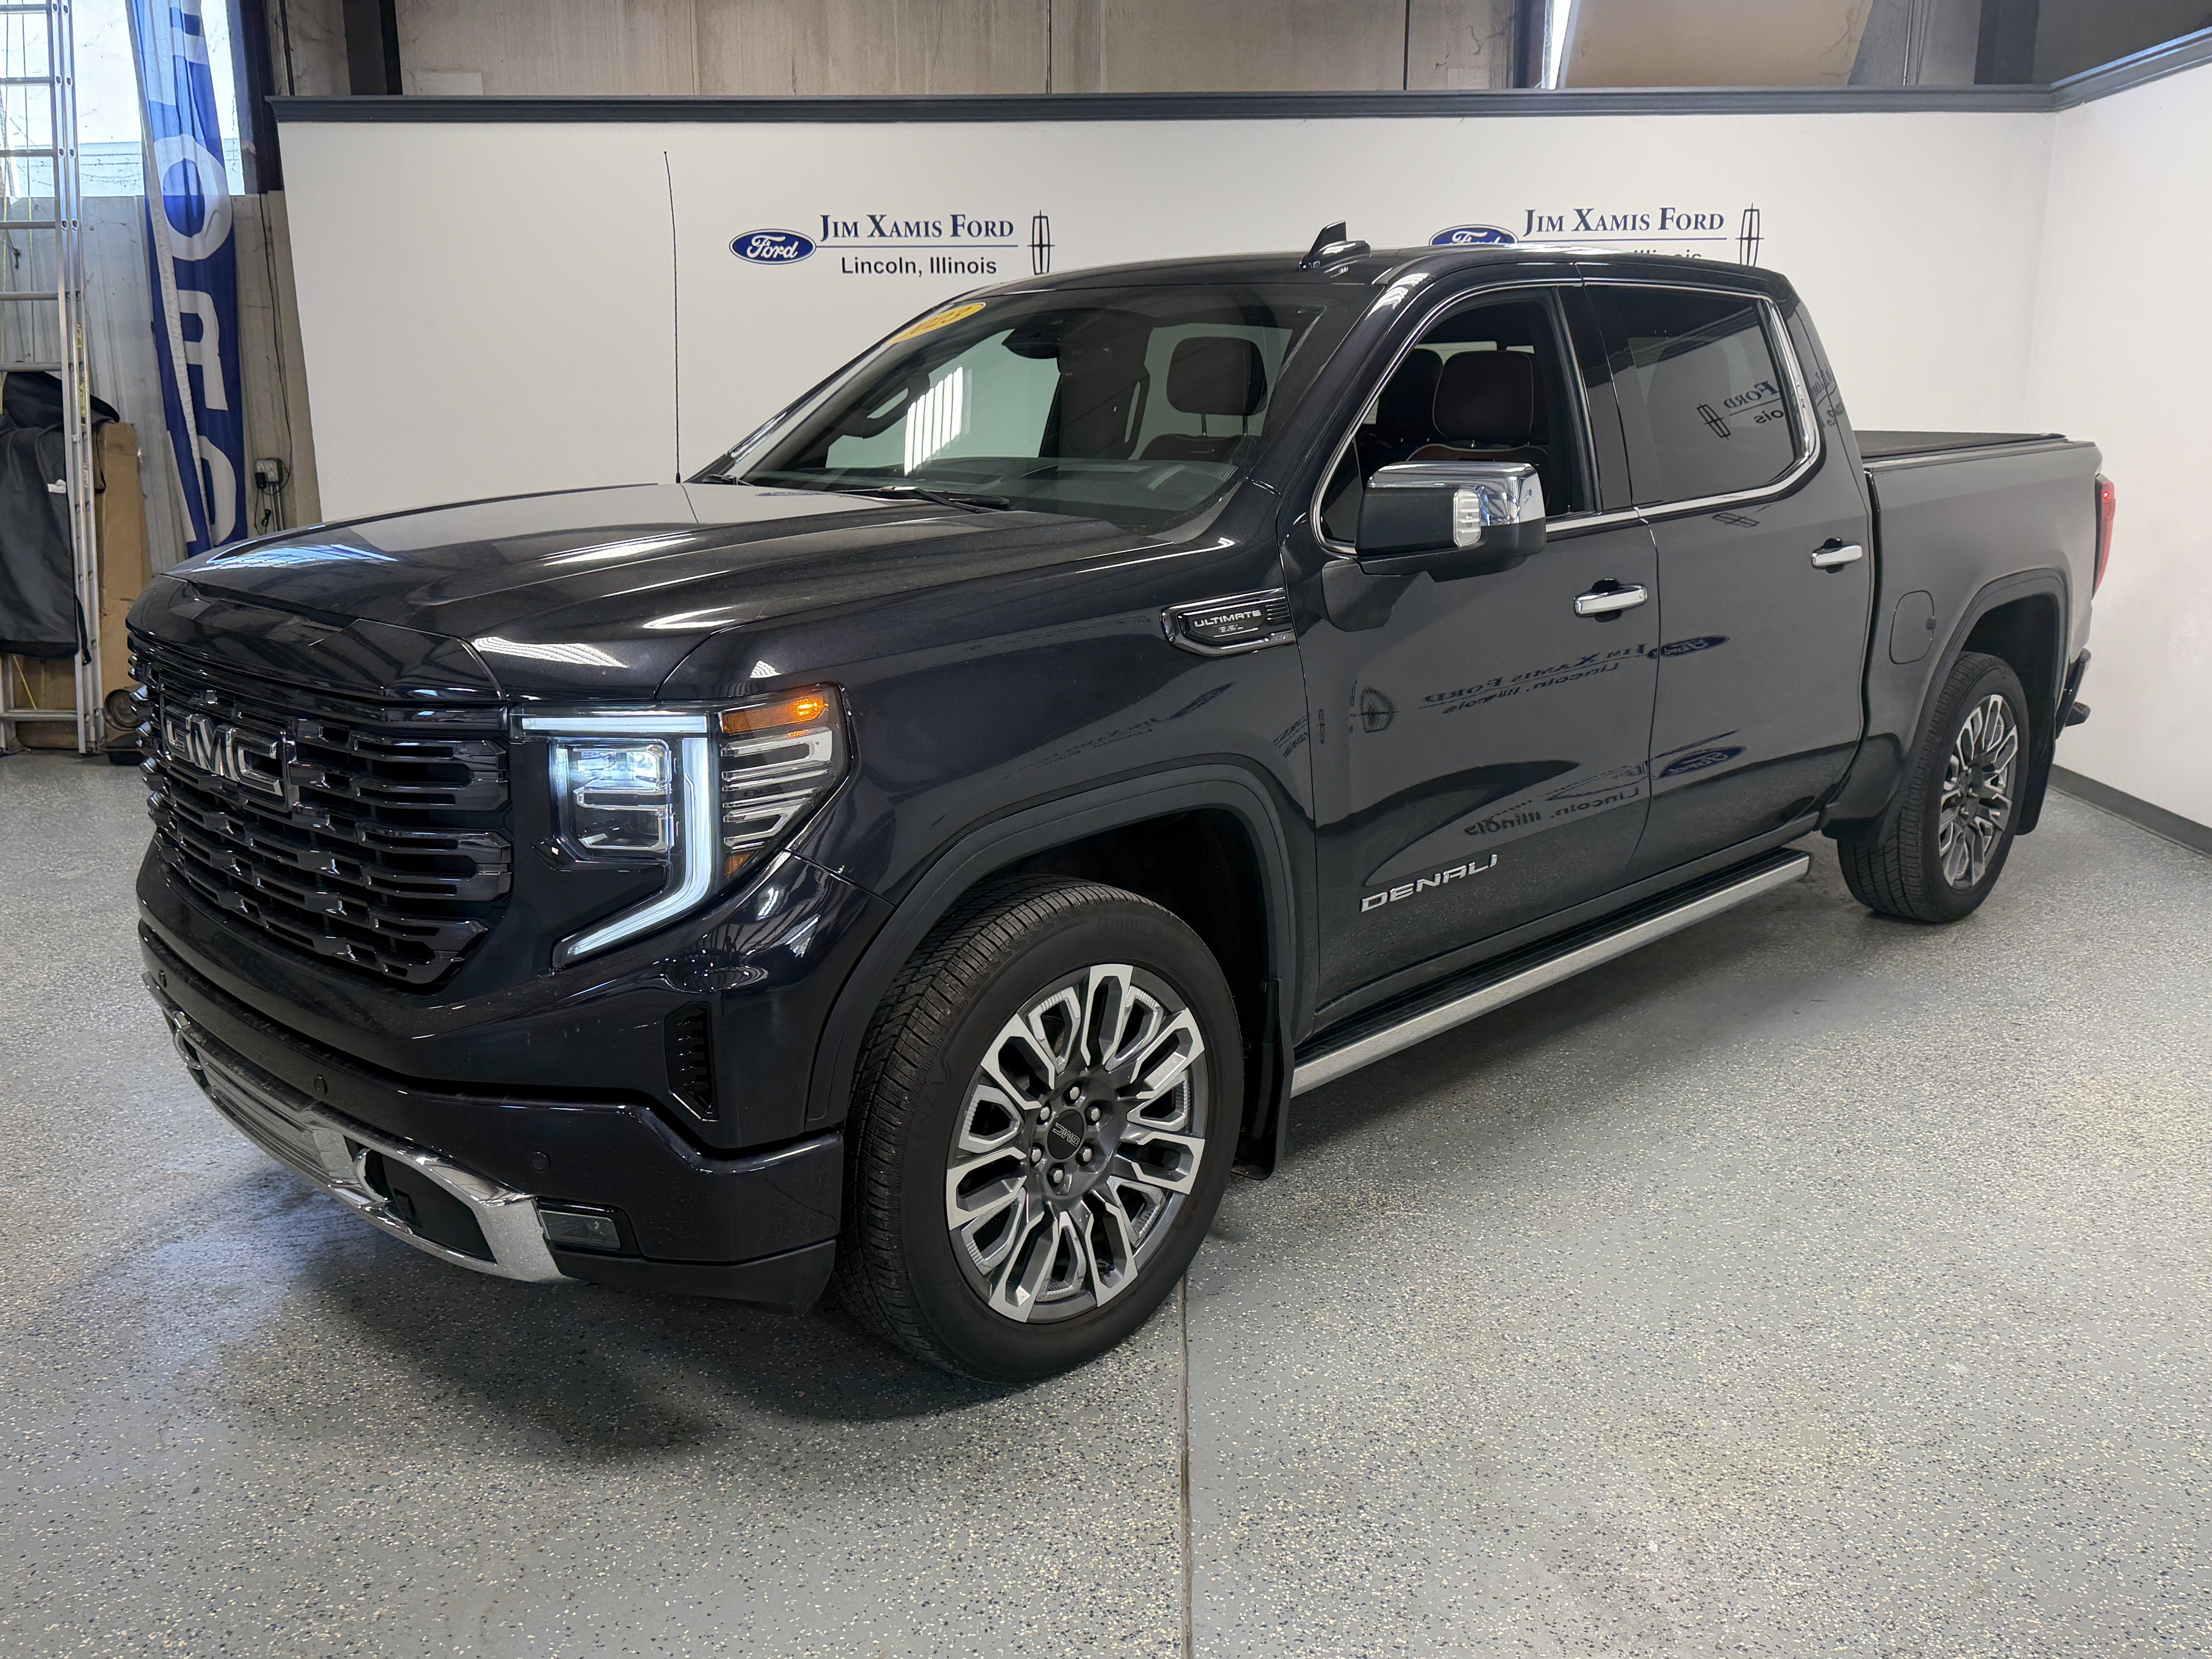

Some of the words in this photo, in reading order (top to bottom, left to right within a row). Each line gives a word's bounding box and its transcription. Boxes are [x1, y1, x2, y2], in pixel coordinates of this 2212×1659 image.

[819, 214, 860, 242] JIM
[866, 214, 943, 238] XAMIS
[950, 214, 1014, 238] FORD
[1523, 209, 1565, 237] JIM
[1571, 208, 1650, 232] XAMIS
[1658, 207, 1724, 230] FORD
[746, 235, 799, 259] Ford
[842, 256, 922, 278] Lincoln,
[930, 256, 997, 274] Illinois
[1194, 610, 1262, 627] ULTIMATE
[163, 704, 285, 797] GMC
[1360, 854, 1498, 913] DENALI
[1052, 1122, 1081, 1147] GMC
